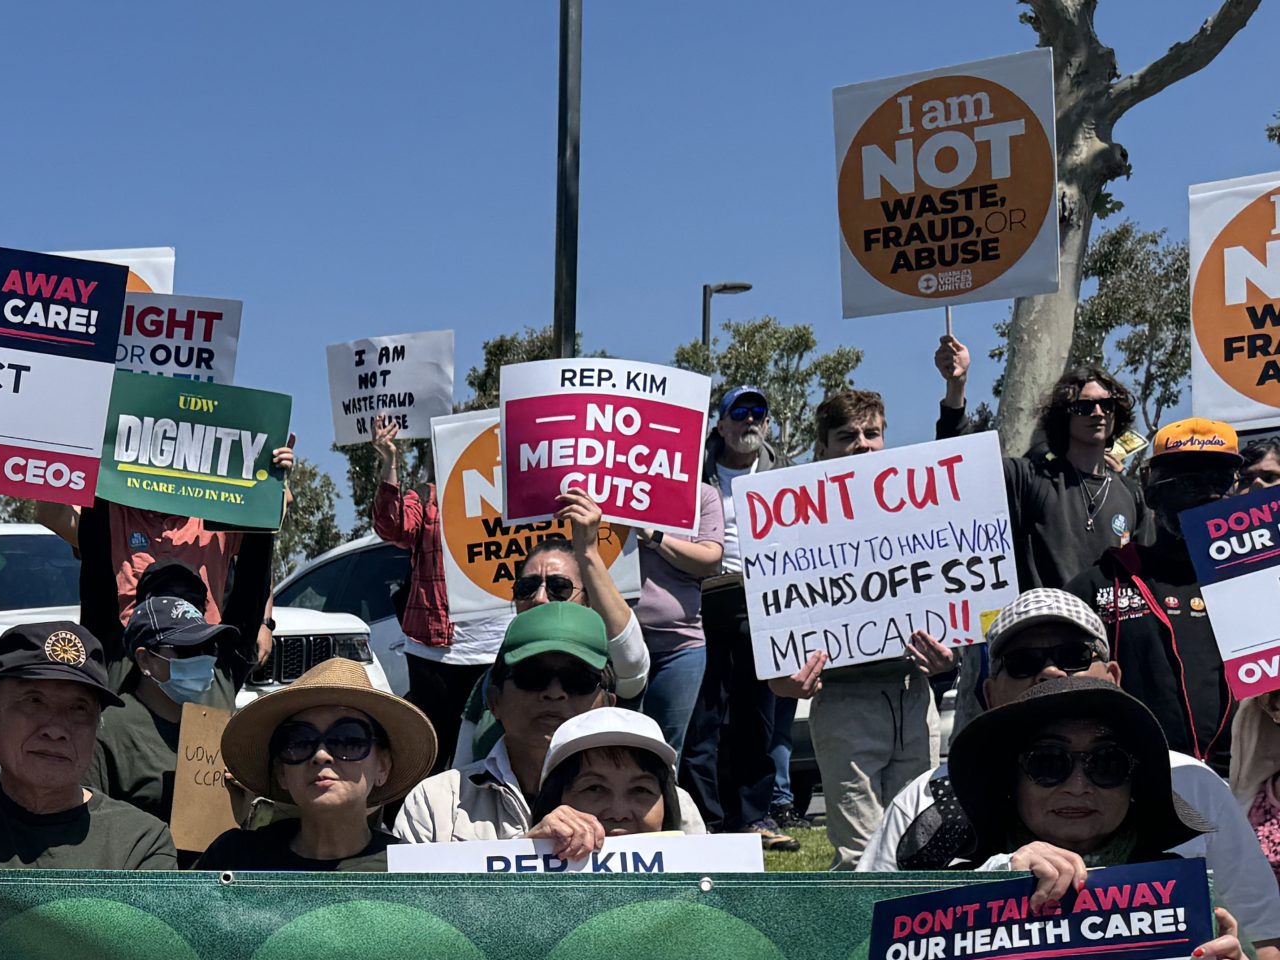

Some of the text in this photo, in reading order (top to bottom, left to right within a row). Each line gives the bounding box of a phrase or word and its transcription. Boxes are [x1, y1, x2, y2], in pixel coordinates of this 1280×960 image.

[896, 91, 994, 135] I am
[861, 118, 1026, 201] NOT
[880, 183, 1007, 223] WASTE,
[863, 208, 1027, 252] FRAUD, OR
[889, 237, 1001, 275] ABUSE
[2, 270, 99, 305] AWAY
[3, 299, 99, 335] CARE!
[123, 305, 223, 342] IGHT
[116, 343, 215, 370] OR OUR
[354, 345, 405, 367] I AM
[358, 369, 391, 389] NOT
[560, 368, 668, 396] REP. KIM
[179, 395, 217, 413] UDW
[342, 395, 375, 415] WASTE
[585, 403, 642, 436] NO
[356, 417, 368, 434] OR
[1184, 435, 1226, 449] Angeles
[114, 414, 269, 481] DIGNITY.
[519, 437, 689, 483] MEDI-CAL
[3, 456, 86, 491] CEOs
[127, 478, 245, 505] IN CARE AND IN PAY.
[559, 472, 652, 511] CUTS
[873, 454, 963, 513] CUT
[1207, 501, 1280, 539] DON'
[781, 540, 860, 575] ABILITY
[864, 535, 893, 563] TO
[900, 527, 950, 557] HAVE
[948, 518, 1012, 553] WORK
[1209, 528, 1274, 561] OUR
[860, 560, 935, 602] OFF
[940, 555, 1010, 594] SSI
[185, 745, 220, 765] UDW
[893, 904, 984, 939] DON'T
[1072, 880, 1176, 913] AWAY
[953, 919, 1070, 956] HEALTH
[1079, 908, 1188, 941] CARE!
